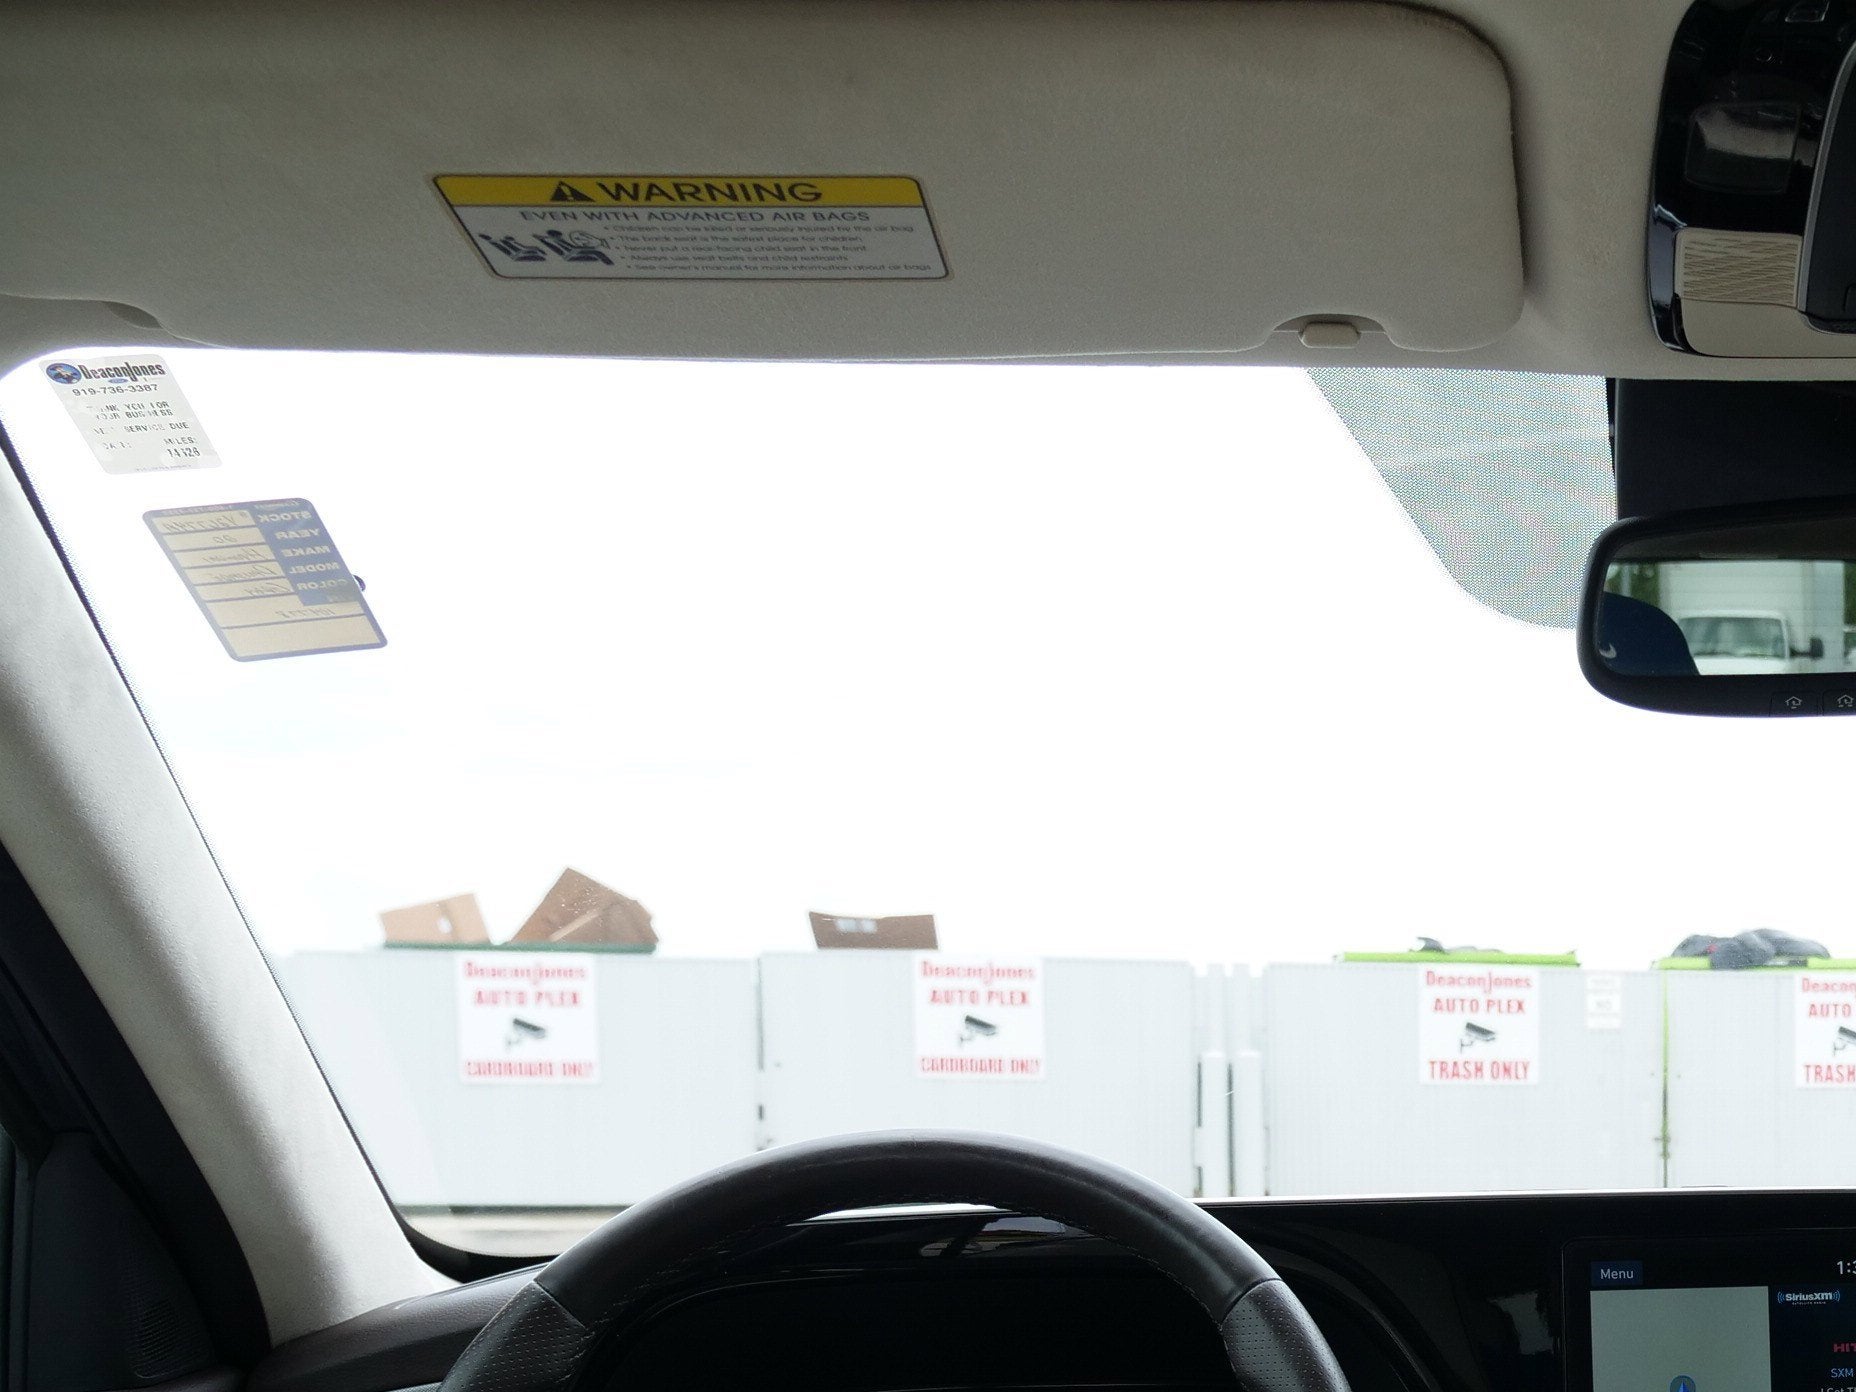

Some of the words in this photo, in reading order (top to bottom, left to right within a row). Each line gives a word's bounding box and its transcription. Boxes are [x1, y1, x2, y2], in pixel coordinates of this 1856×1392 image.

[596, 181, 823, 203] WARNING
[520, 211, 578, 222] EVEN
[582, 211, 640, 222] WITH
[647, 211, 764, 222] ADVANCED
[772, 212, 807, 222] AIR
[813, 212, 870, 222] BAGS
[930, 990, 979, 1005] AUTO
[1434, 998, 1479, 1013] AUTO
[1486, 999, 1525, 1014] PLEX
[1808, 1003, 1852, 1018] AUTO
[1429, 1060, 1484, 1080] TRASH
[1490, 1060, 1530, 1080] ONLY
[1804, 1064, 1856, 1083] TRASH
[1600, 1268, 1634, 1280] Menu
[1830, 1367, 1854, 1378] SXM
